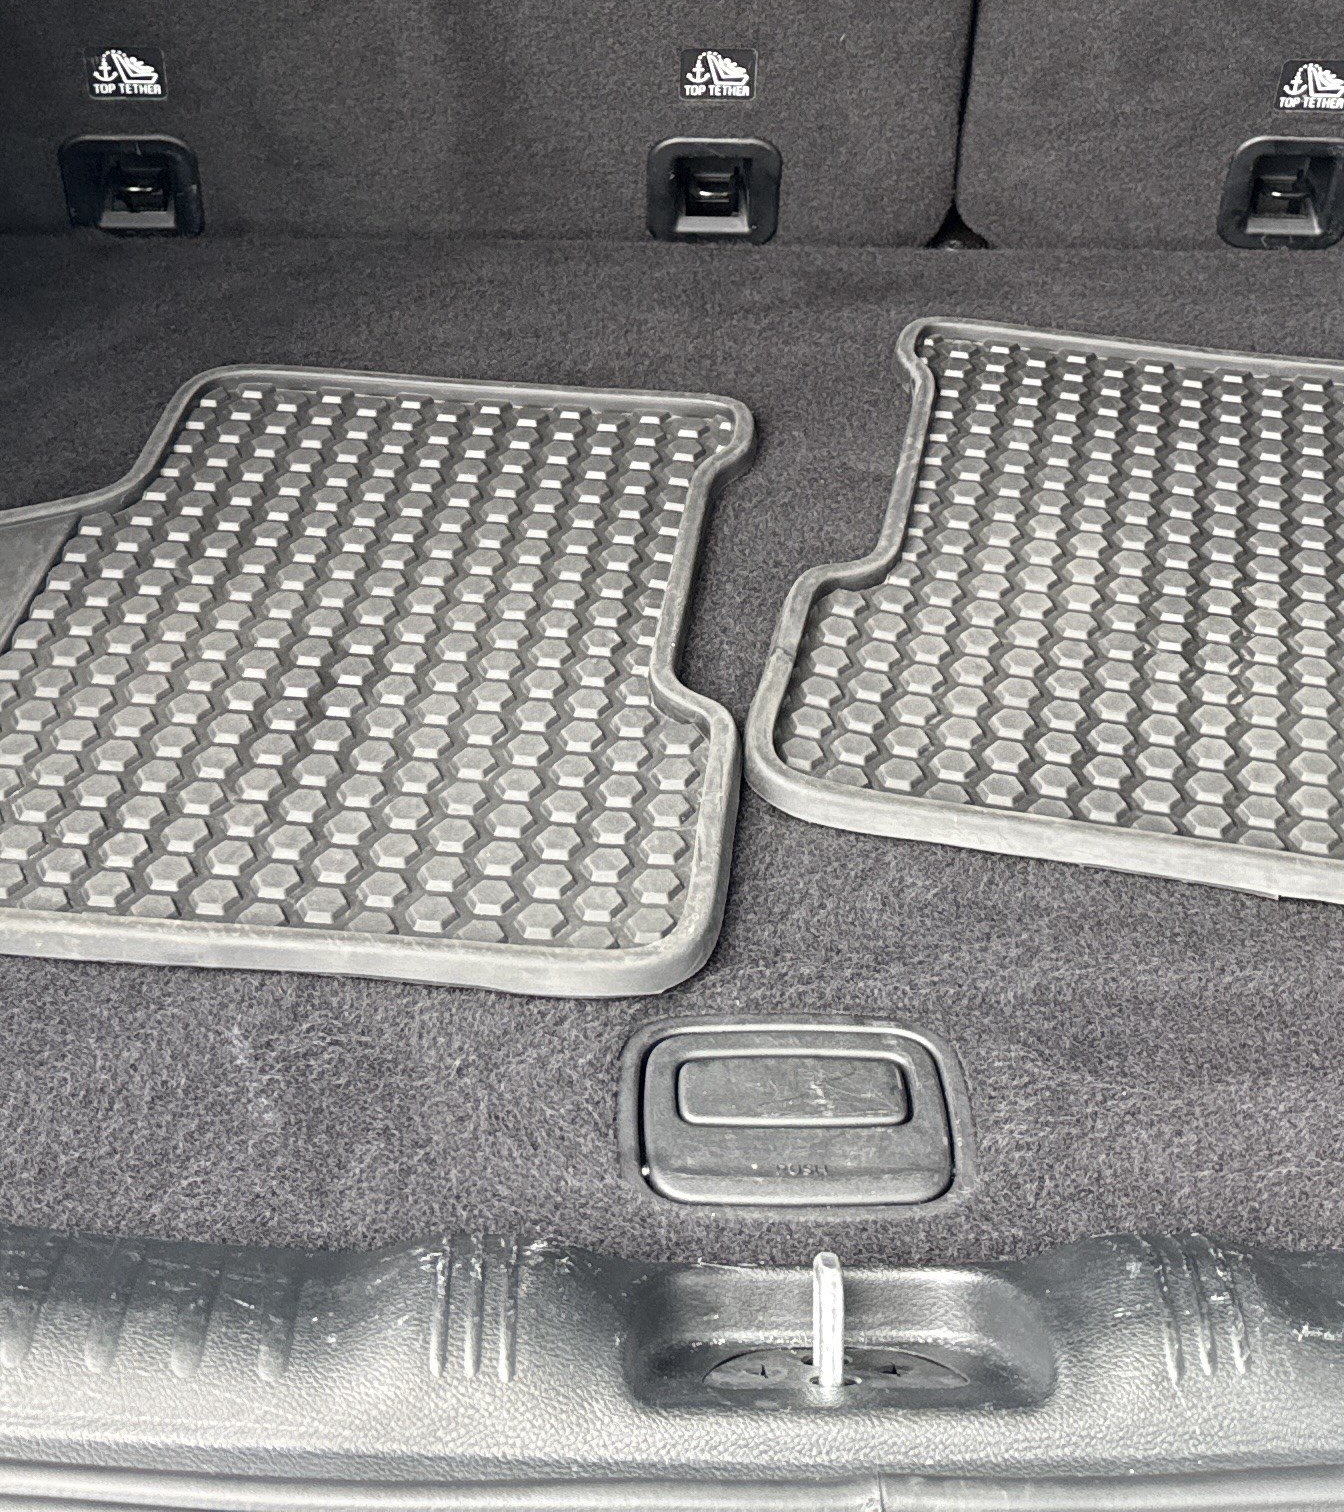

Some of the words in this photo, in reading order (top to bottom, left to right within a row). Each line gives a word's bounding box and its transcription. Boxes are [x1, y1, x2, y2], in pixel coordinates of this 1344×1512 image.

[93, 83, 117, 95] TOP
[119, 83, 162, 95] TETHER
[684, 84, 706, 96] TOP
[708, 84, 750, 97] TETHER
[1279, 96, 1301, 108] TOP
[1302, 96, 1344, 110] TETHER
